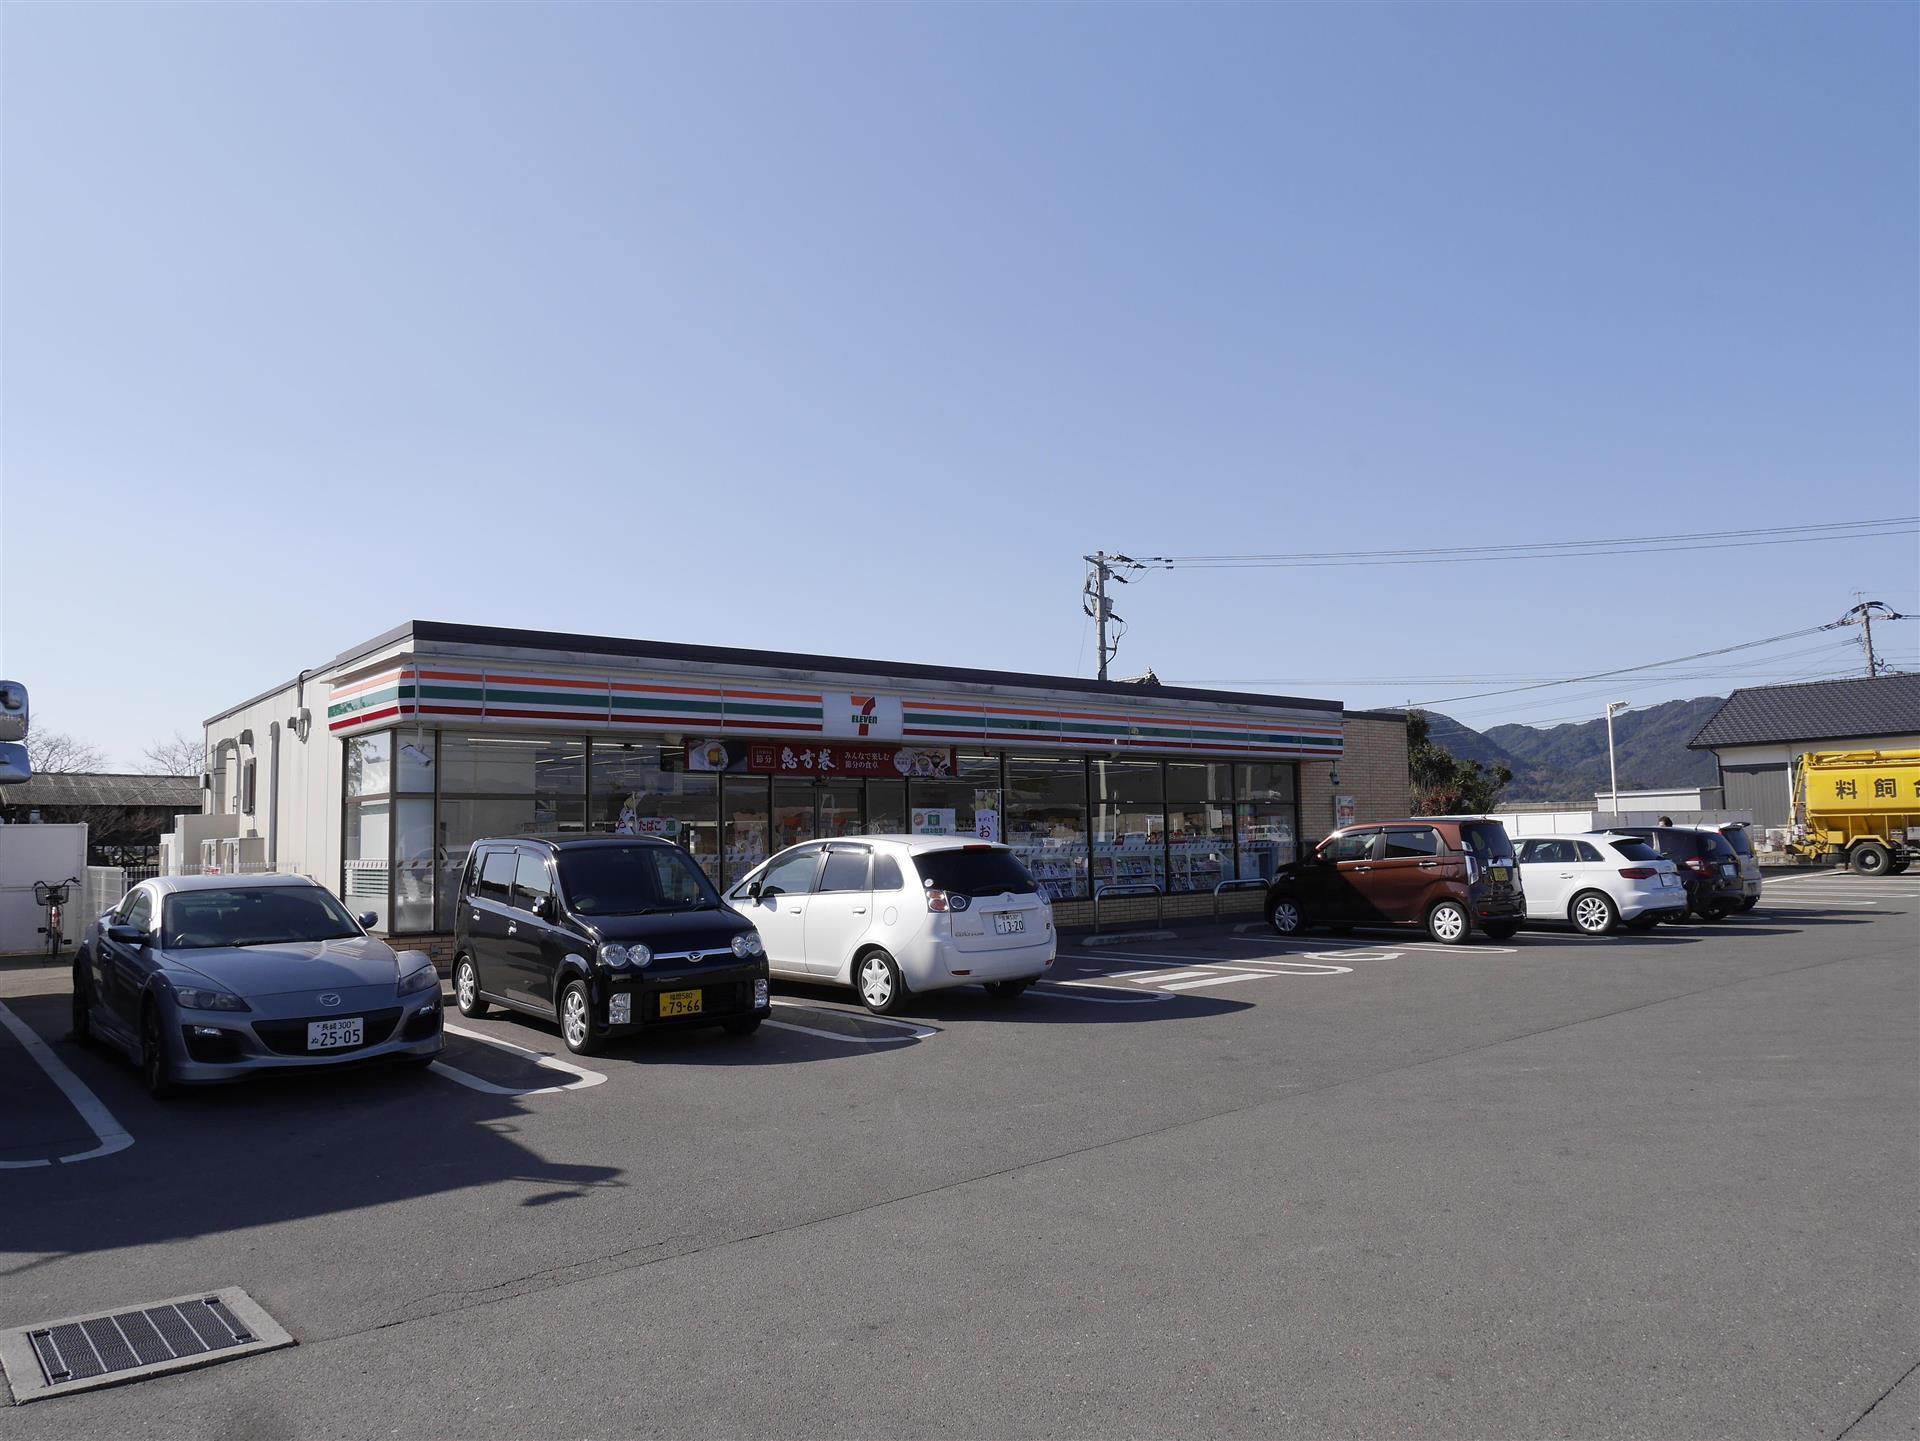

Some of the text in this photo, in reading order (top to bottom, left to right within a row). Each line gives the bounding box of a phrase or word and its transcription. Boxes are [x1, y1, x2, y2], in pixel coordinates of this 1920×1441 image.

[1003, 920, 1024, 932] 13-20
[669, 1000, 700, 1014] 79-66
[321, 1029, 360, 1047] 25-05
